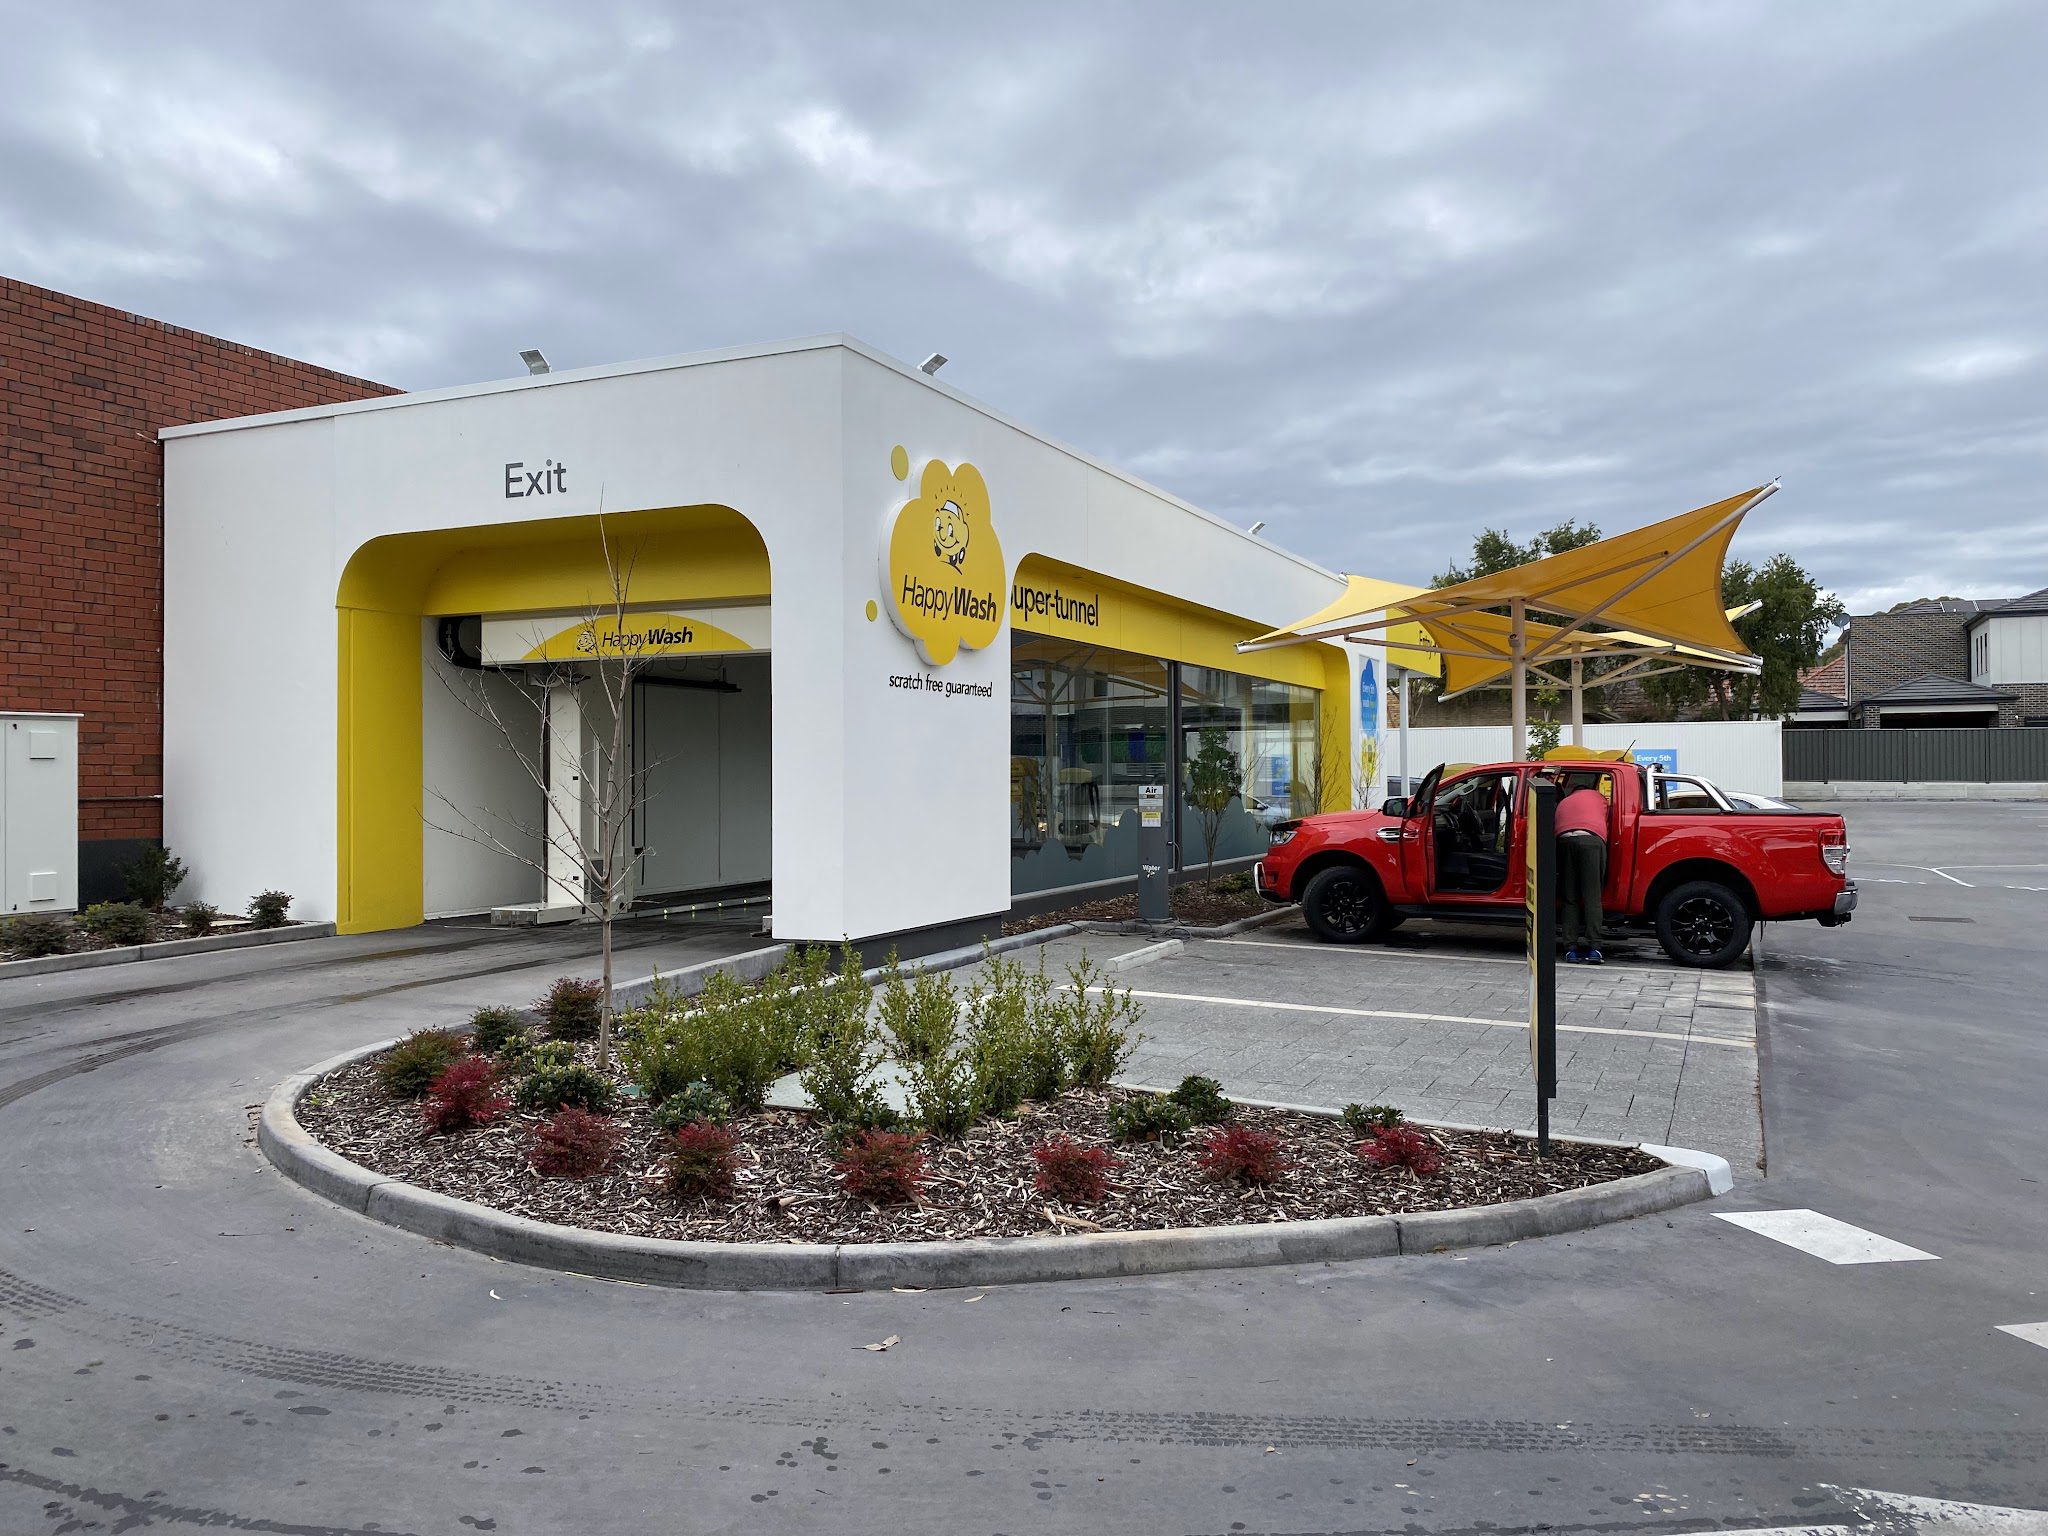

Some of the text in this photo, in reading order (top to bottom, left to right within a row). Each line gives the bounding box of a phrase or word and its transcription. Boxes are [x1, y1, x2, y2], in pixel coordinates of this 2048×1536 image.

[505, 459, 567, 498] Exit
[889, 672, 993, 698] scratch free guaranteed
[1636, 754, 1672, 763] Every 5th
[1145, 786, 1158, 794] Air
[1142, 864, 1161, 872] Water
